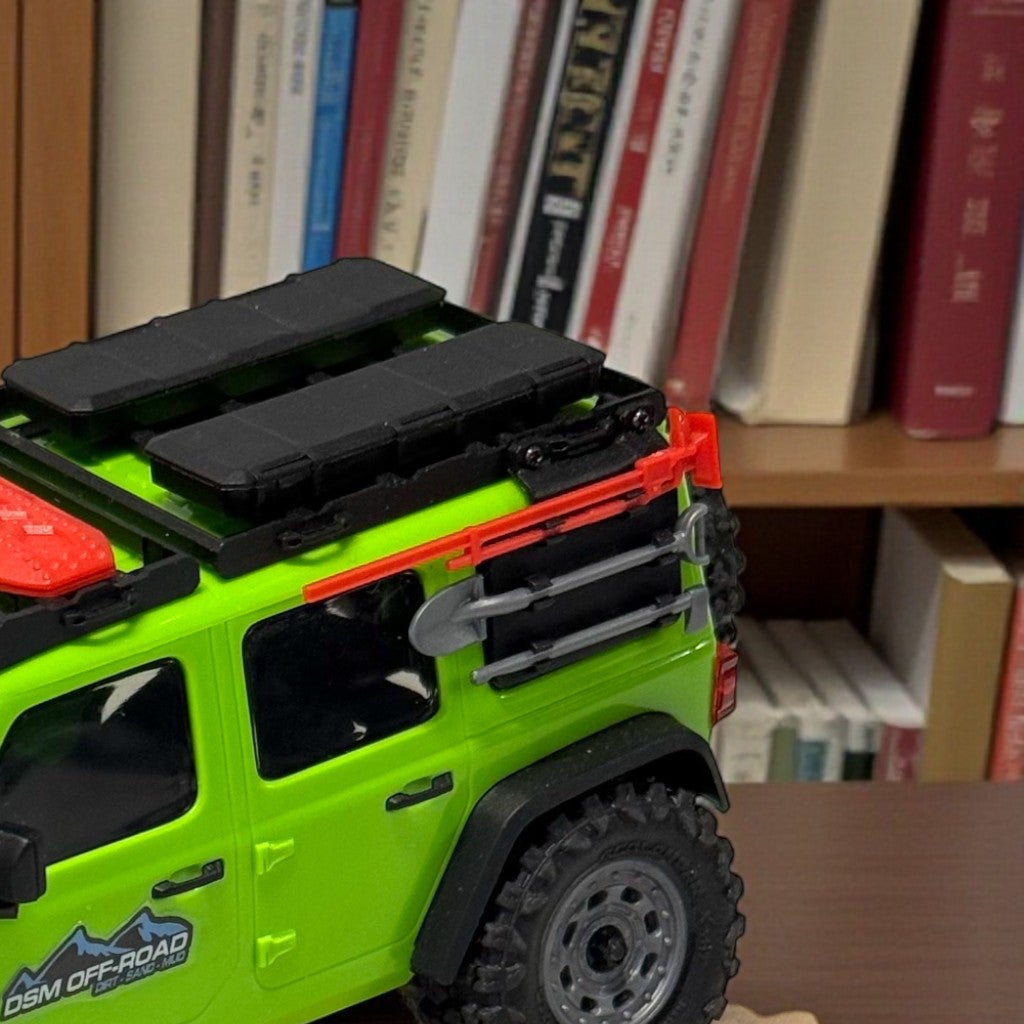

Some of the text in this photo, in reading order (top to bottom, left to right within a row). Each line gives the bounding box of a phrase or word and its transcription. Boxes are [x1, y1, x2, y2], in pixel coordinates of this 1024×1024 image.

[3, 931, 189, 1017] DSM OFF-ROAD
[95, 950, 187, 993] DIRT SAND MUD
